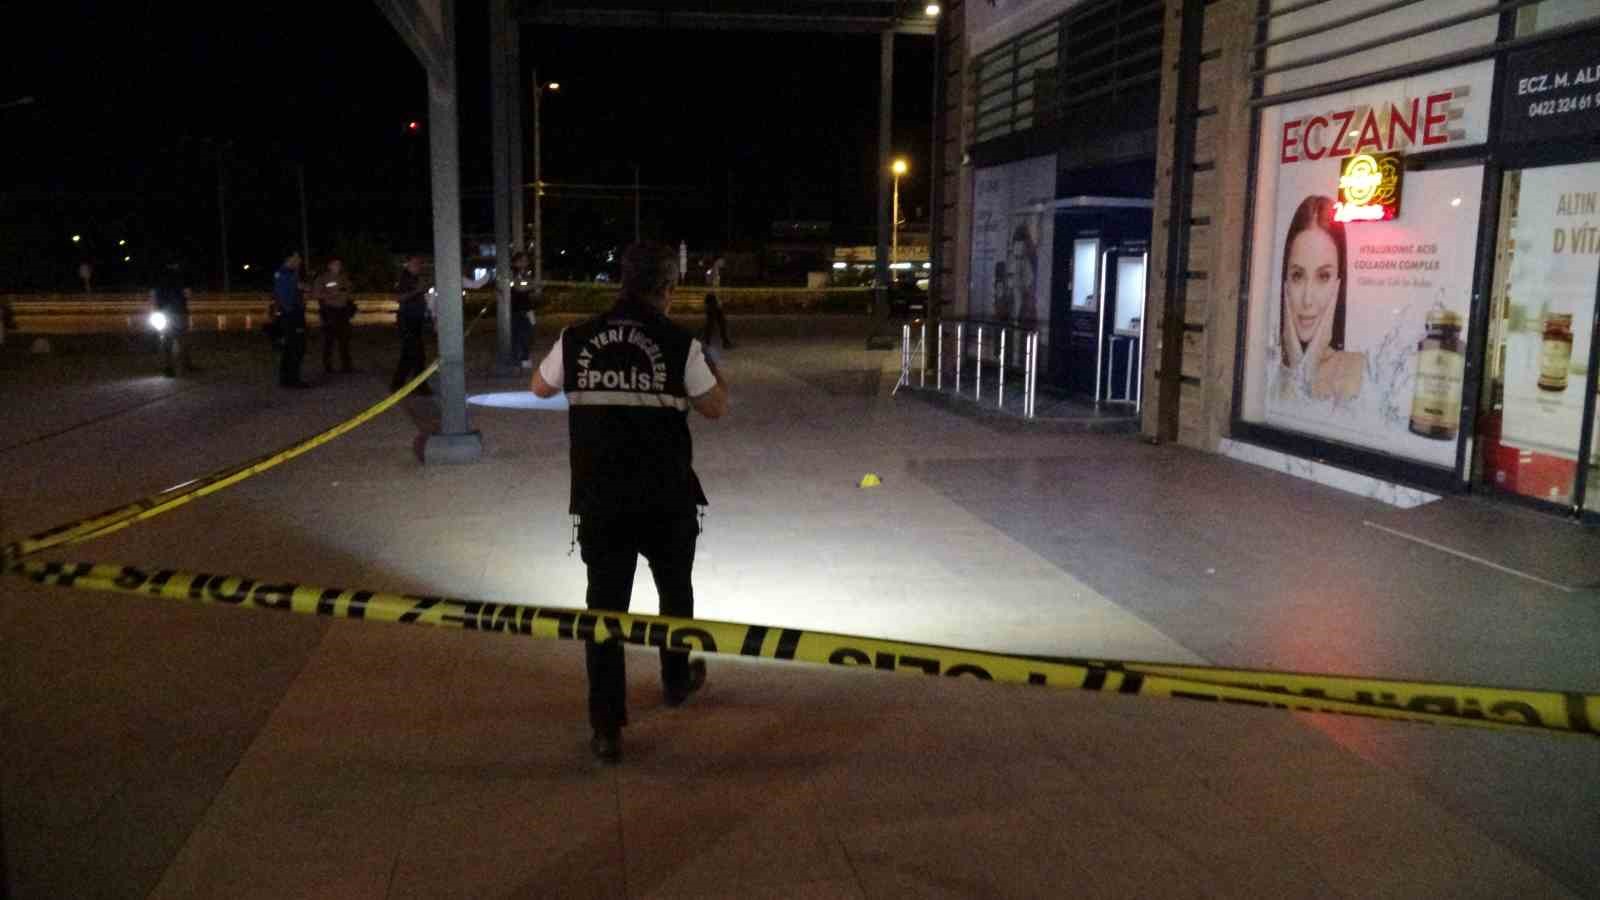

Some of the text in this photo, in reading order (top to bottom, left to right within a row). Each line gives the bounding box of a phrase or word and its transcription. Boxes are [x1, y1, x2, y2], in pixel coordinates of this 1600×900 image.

[1518, 74, 1552, 96] ECZ.
[1554, 72, 1570, 88] M.
[1529, 100, 1555, 118] 0422
[1557, 97, 1577, 112] 324
[1579, 94, 1591, 110] 61
[1281, 92, 1453, 164] ECZANE
[1417, 242, 1438, 255] ACID
[1553, 227, 1566, 253] D
[1354, 260, 1440, 272] COLLAGEN COMPLEX
[588, 366, 651, 391] POLİS
